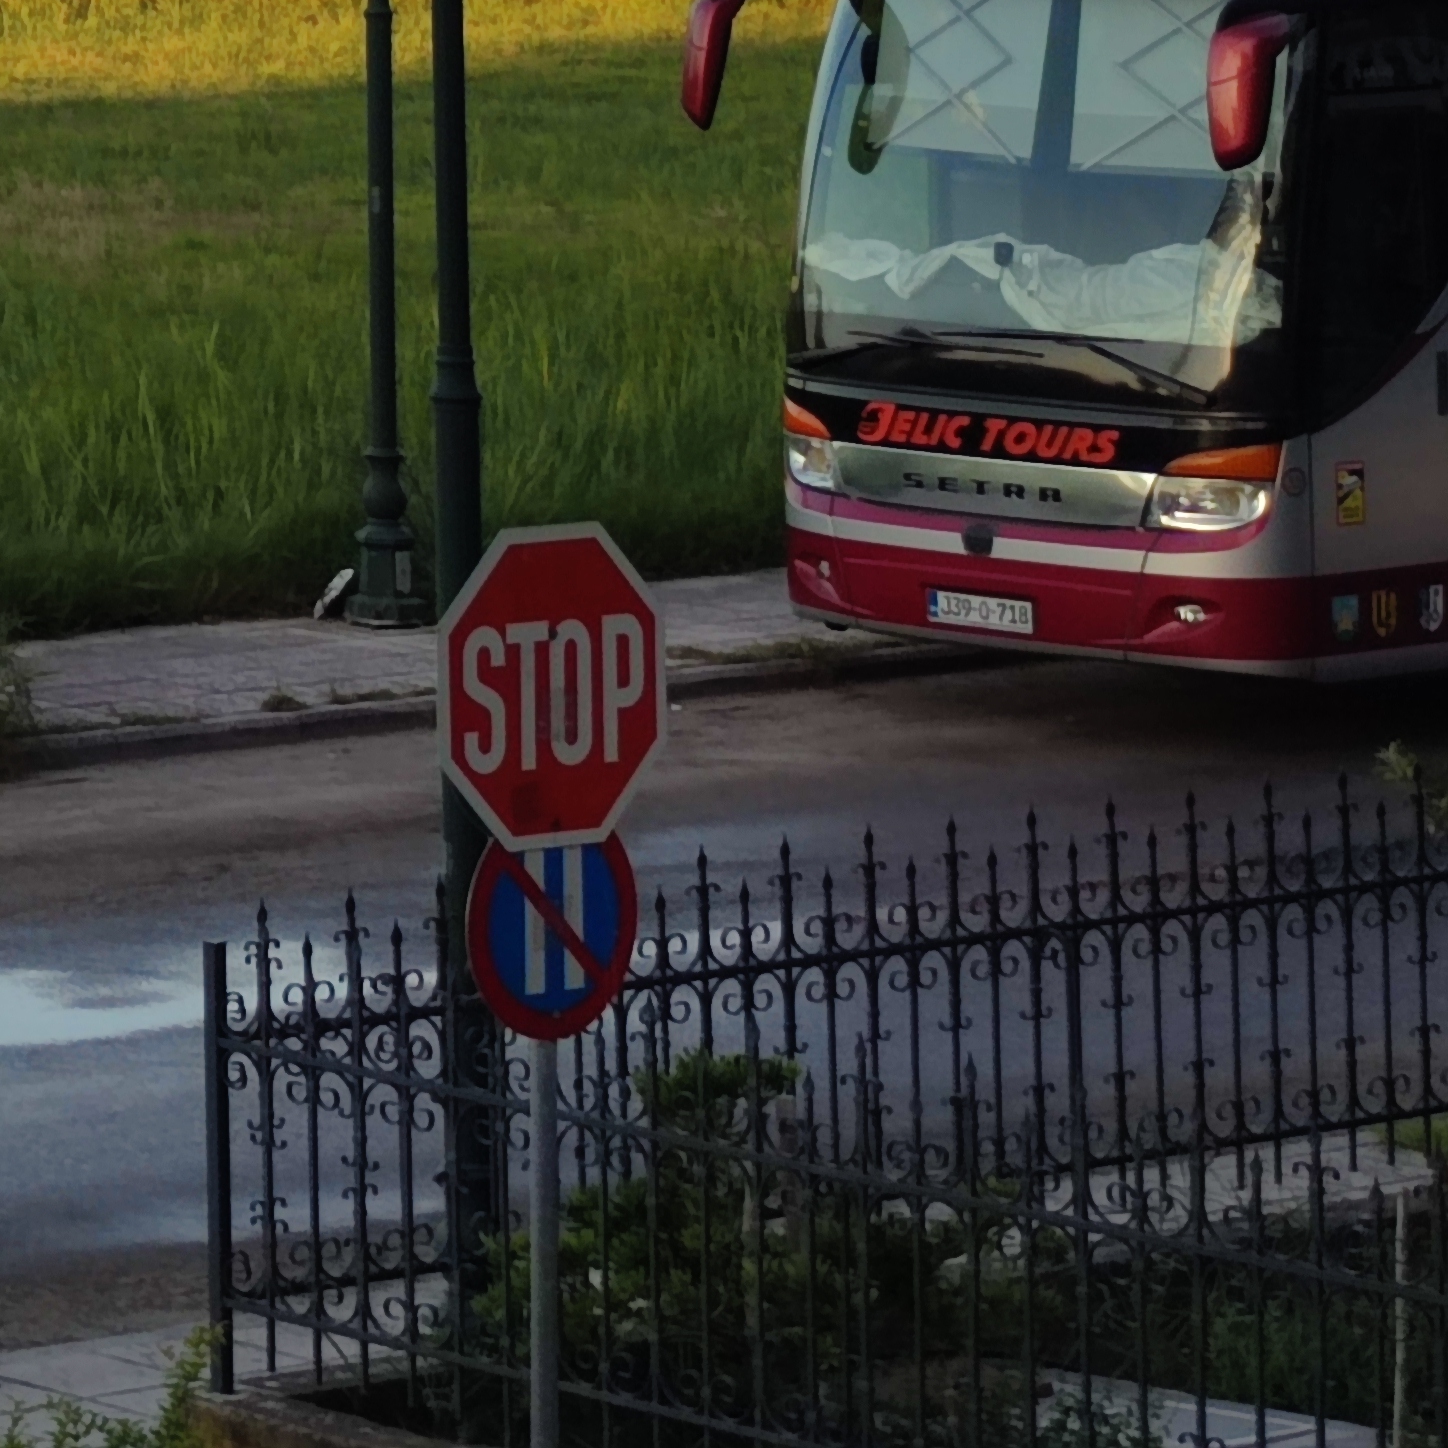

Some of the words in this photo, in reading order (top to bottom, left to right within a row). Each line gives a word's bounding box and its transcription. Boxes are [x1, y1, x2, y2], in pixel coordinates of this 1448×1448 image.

[857, 400, 971, 449] JELIC
[980, 417, 1120, 464] TOURS
[902, 472, 1063, 503] SETRA
[463, 613, 645, 776] STOP
